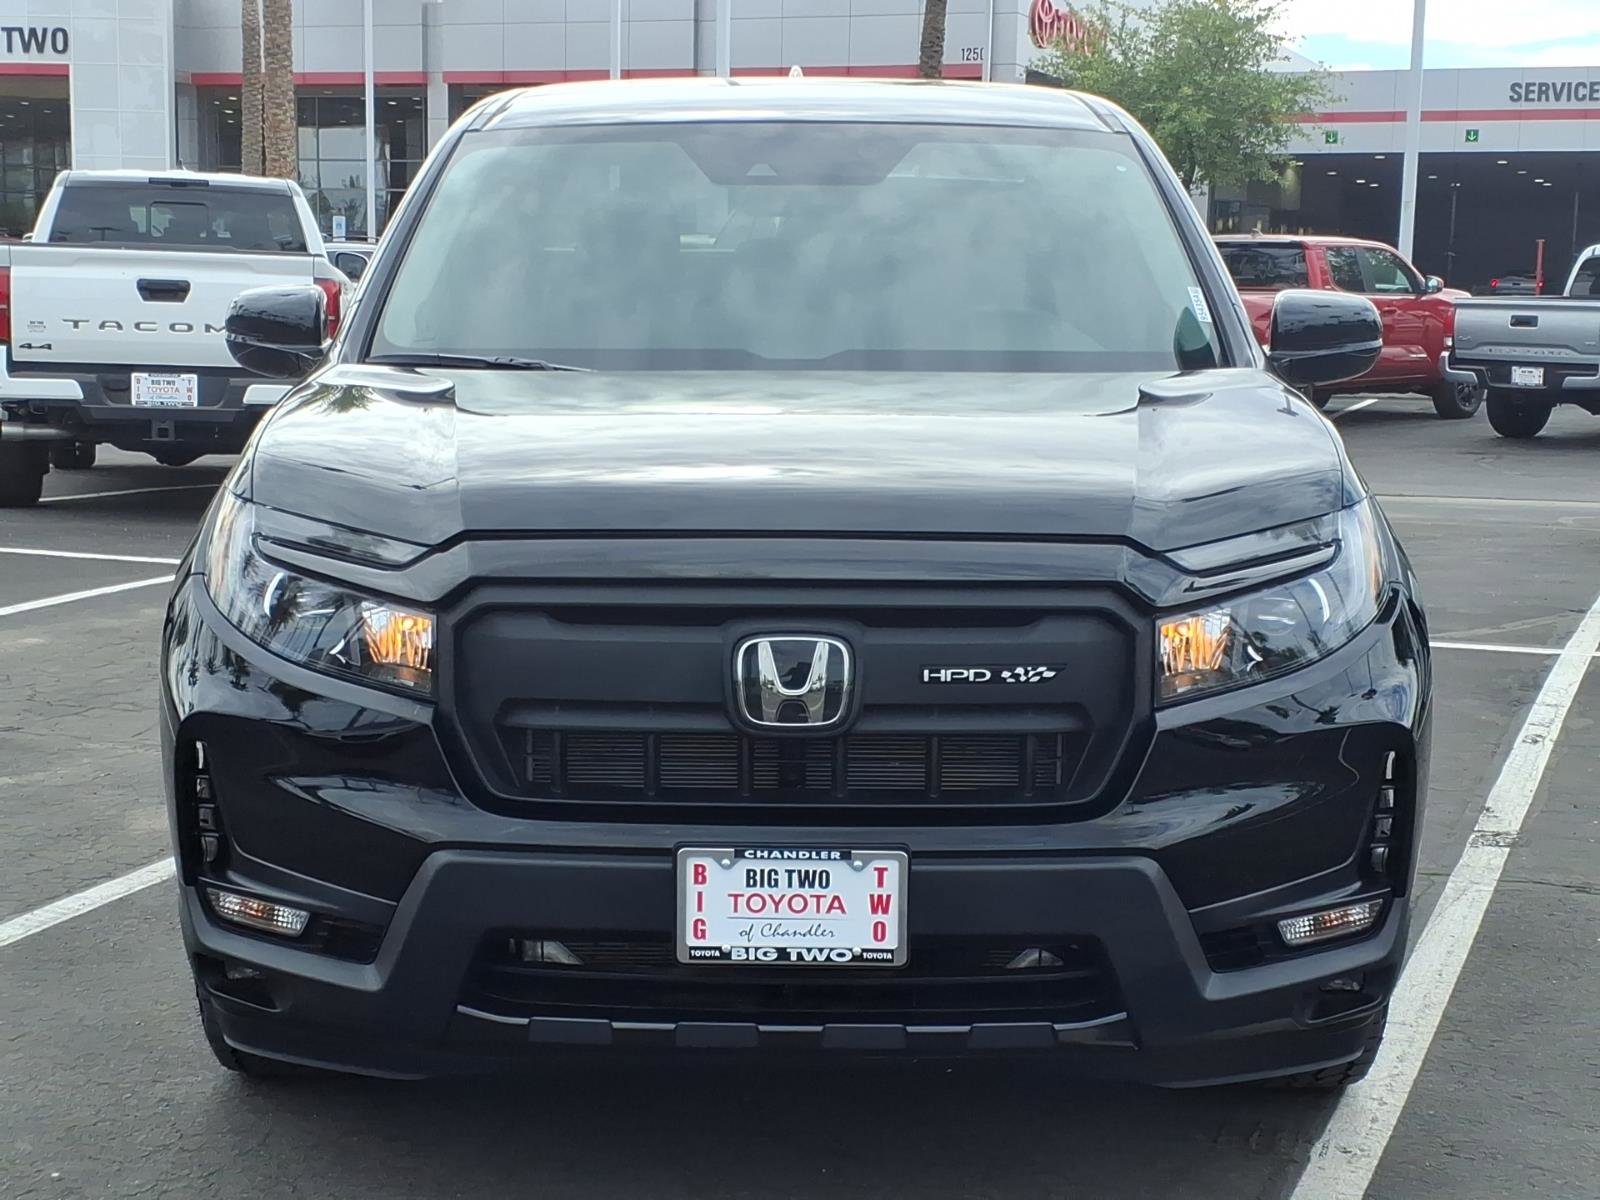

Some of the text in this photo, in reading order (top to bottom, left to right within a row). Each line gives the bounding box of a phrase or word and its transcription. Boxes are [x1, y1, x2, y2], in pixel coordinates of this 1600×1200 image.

[0, 26, 69, 55] TWO
[1508, 81, 1600, 103] SERVICE
[62, 319, 227, 333] TACOM
[923, 669, 992, 683] HPD
[744, 850, 841, 860] CHANDLER
[745, 868, 831, 890] BIG TWO
[727, 893, 847, 914] TOYOTA
[739, 922, 836, 942] of Chandler
[690, 949, 720, 957] TOYOTA
[731, 947, 853, 962] BIG TWO
[862, 952, 893, 960] TOYOTA
